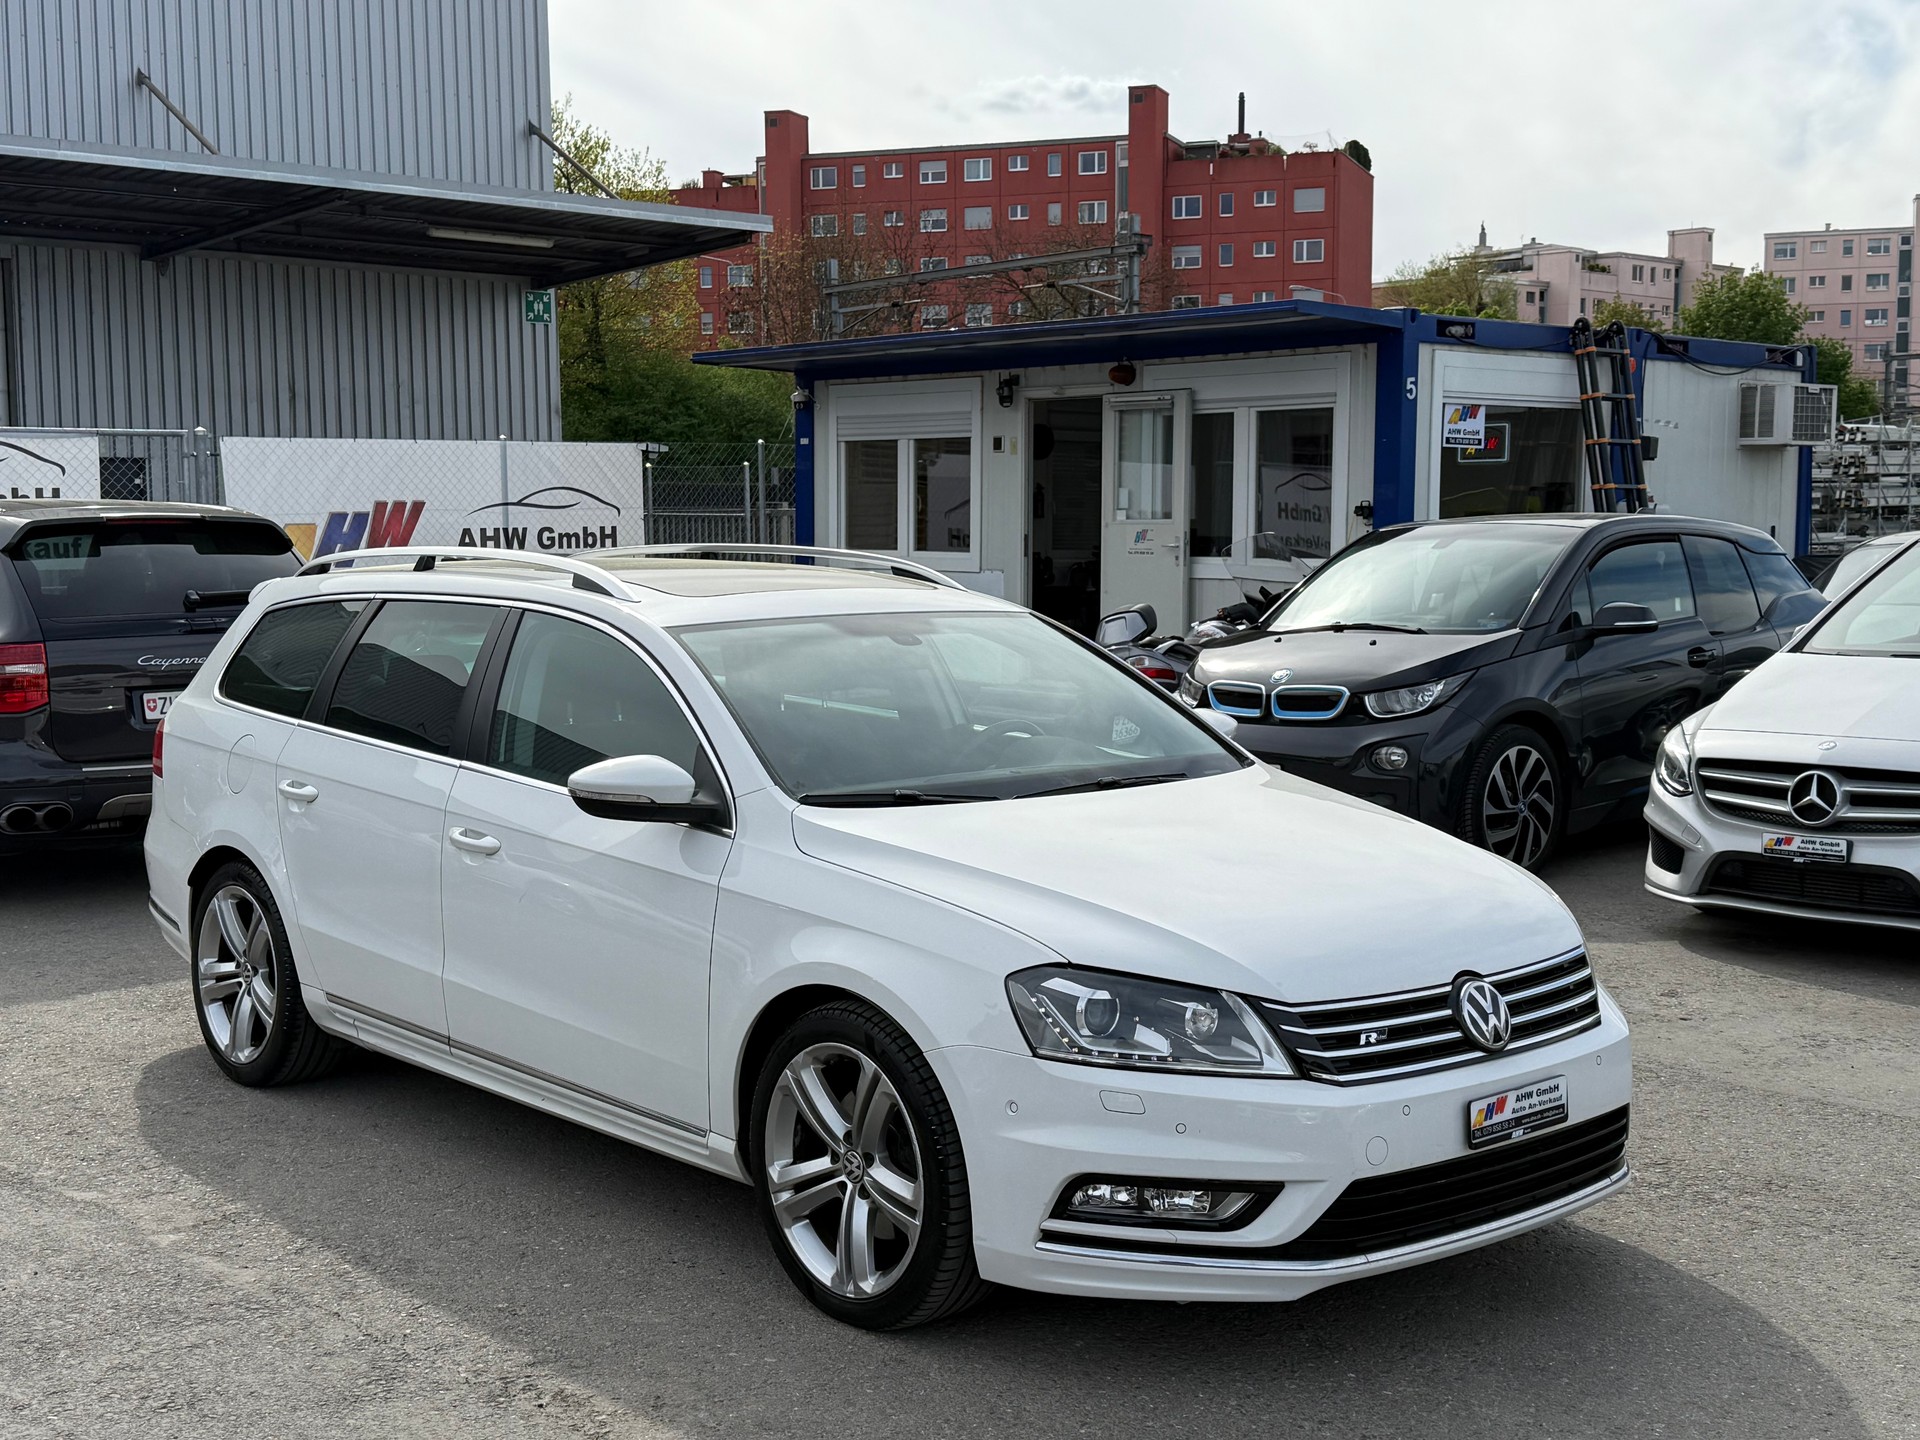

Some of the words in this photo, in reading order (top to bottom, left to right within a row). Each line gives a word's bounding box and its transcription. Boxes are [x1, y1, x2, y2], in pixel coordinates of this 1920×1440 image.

[1406, 377, 1416, 400] 5
[1448, 405, 1481, 424] AHW
[1447, 428, 1461, 436] AHW
[1462, 429, 1480, 437] GmbH
[458, 527, 527, 549] AHW
[537, 525, 618, 549] GmbH
[138, 655, 207, 670] Cayenne
[158, 696, 172, 716] Z
[1765, 836, 1794, 849] AHW
[1515, 1090, 1534, 1103] AHW
[1535, 1084, 1559, 1097] GmbH
[1472, 1095, 1508, 1128] AHW
[1512, 1105, 1526, 1114] Auto
[1528, 1094, 1562, 1110] An-Verkauf
